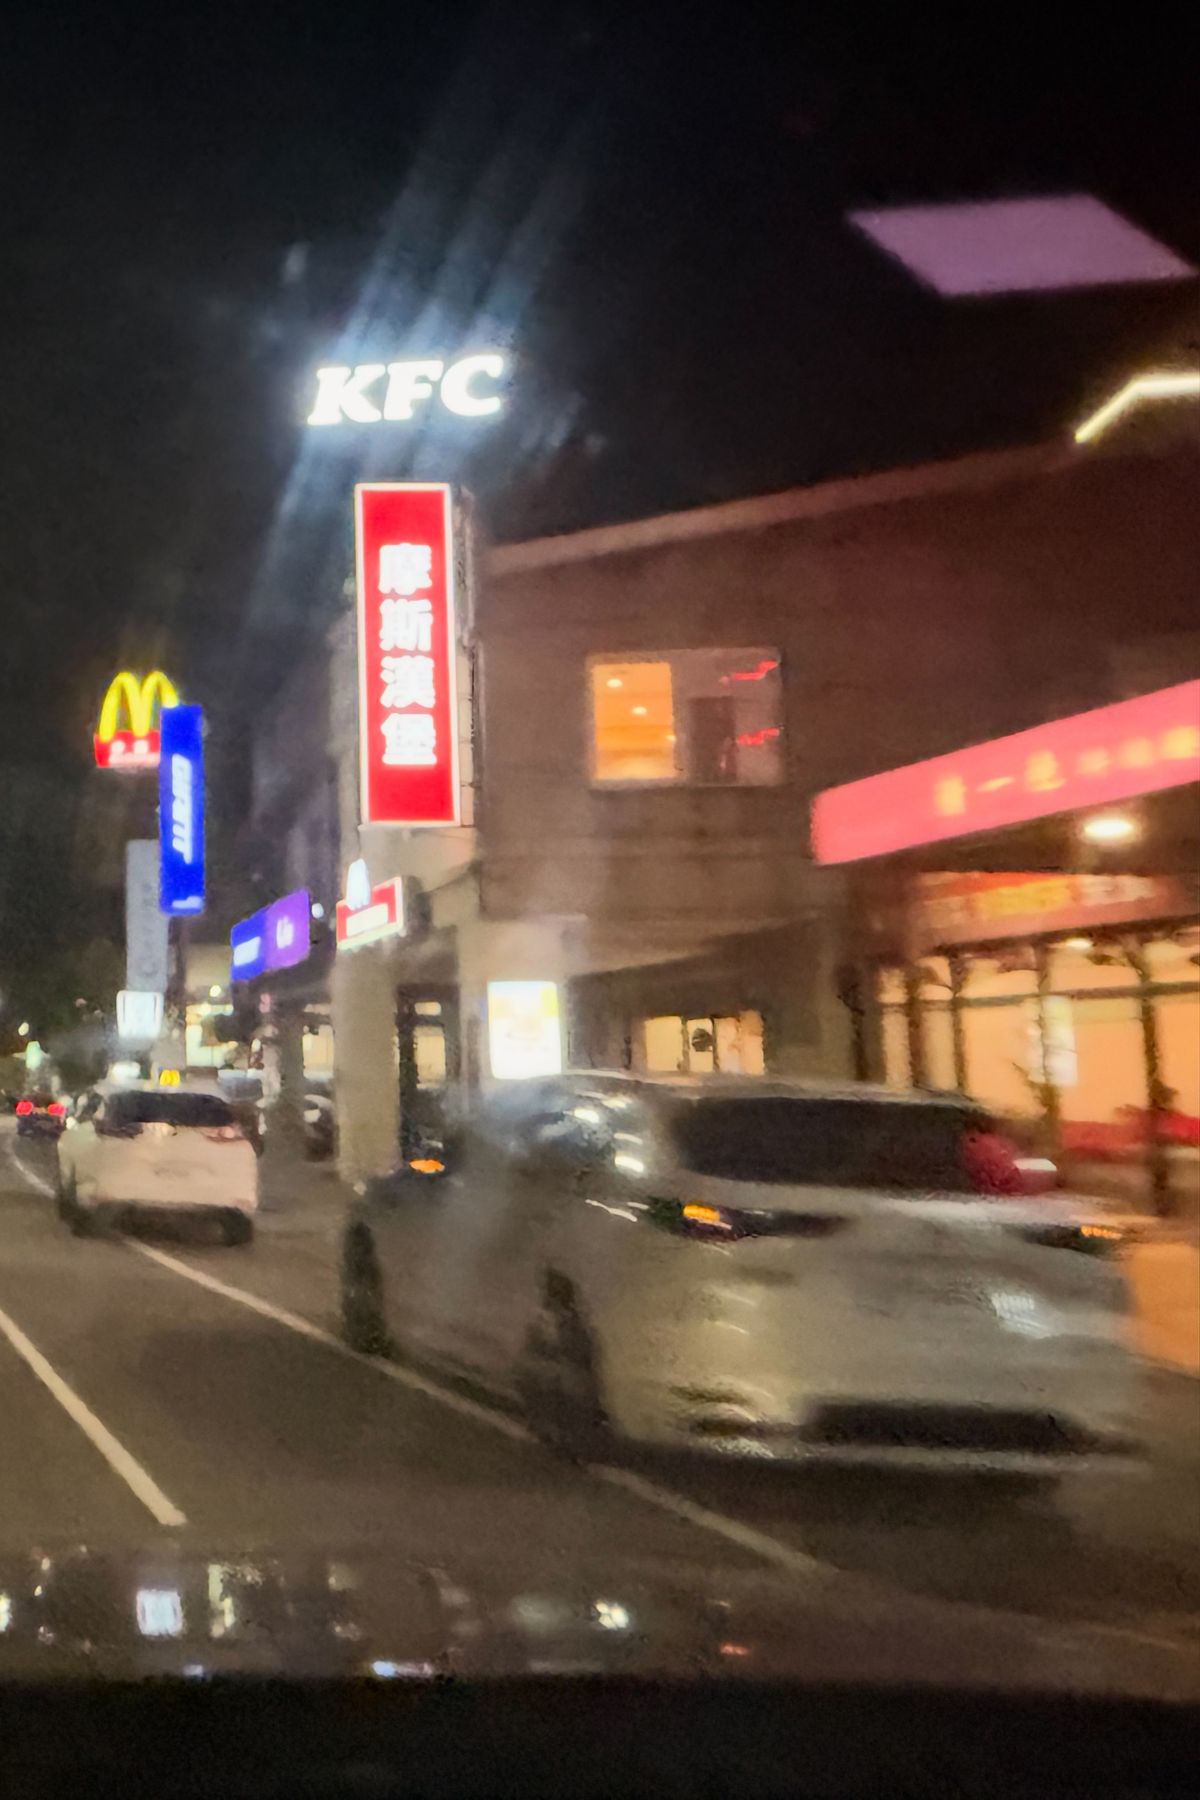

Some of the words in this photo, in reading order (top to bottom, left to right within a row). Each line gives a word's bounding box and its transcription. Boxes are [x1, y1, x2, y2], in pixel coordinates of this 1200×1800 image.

[307, 355, 504, 426] KFC
[379, 542, 437, 765] 摩斯漢堡
